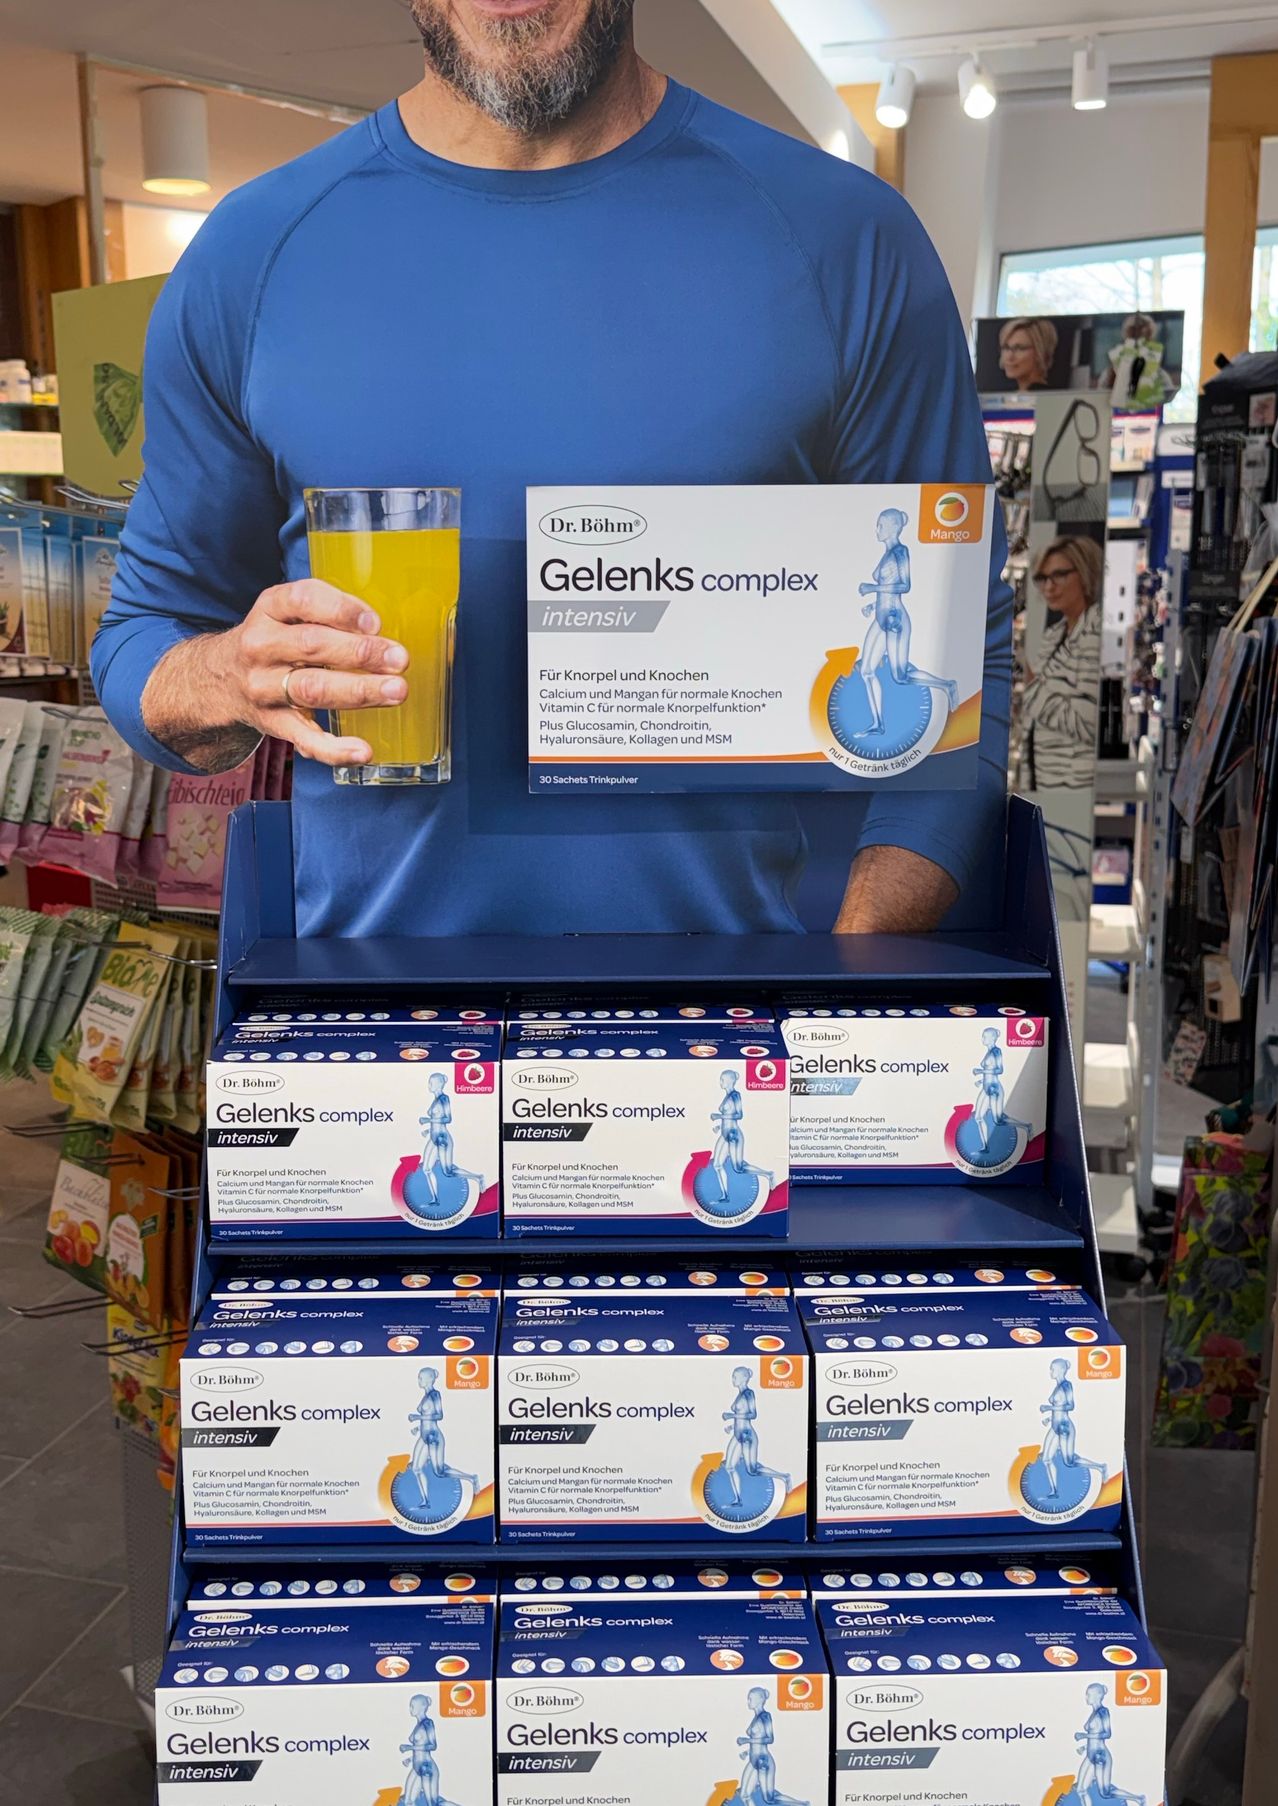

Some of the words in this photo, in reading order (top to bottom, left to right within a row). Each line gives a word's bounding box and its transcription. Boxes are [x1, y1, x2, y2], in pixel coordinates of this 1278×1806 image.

[550, 518, 576, 533] Dr.
[931, 529, 970, 541] Mango
[540, 558, 693, 592] Gelenks
[702, 568, 818, 597] complex
[542, 607, 635, 627] intensiv
[540, 669, 560, 681] Für
[564, 669, 615, 683] Knorpel
[620, 669, 645, 681] und
[650, 669, 709, 681] Knochen
[539, 689, 586, 699] Calcium
[589, 689, 611, 699] und
[615, 690, 658, 701] Mangan
[661, 689, 678, 699] für
[680, 689, 728, 699] normale
[731, 689, 782, 699] Knochen
[539, 703, 584, 713] Vitamin
[588, 704, 595, 713] C
[598, 703, 614, 713] für
[617, 703, 664, 713] normale
[539, 721, 563, 731] Plus
[566, 721, 637, 732] Glucosamin,
[640, 720, 712, 732] Chondroitin,
[539, 734, 627, 746] Hyaluronsäure,
[630, 734, 676, 747] Kollagen
[680, 734, 702, 744] und
[705, 734, 732, 744] MSM
[828, 746, 845, 760] nur
[844, 758, 849, 767] 1
[849, 761, 888, 773] Getränk
[889, 748, 921, 770] täglich
[539, 776, 551, 784] 30
[553, 776, 587, 784] Sachets
[589, 776, 638, 786] Trinkpulver
[793, 1033, 809, 1041] Dr.
[881, 1060, 948, 1076] complex
[223, 1078, 240, 1087] Dr.
[519, 1075, 535, 1083] Dr.
[216, 1102, 315, 1123] Gelenks
[319, 1108, 393, 1125] complex
[512, 1098, 607, 1118] Gelenks
[613, 1104, 685, 1121] complex
[800, 1116, 831, 1124] Knorpel
[513, 1126, 571, 1138] intensiv
[217, 1132, 278, 1144] intensiv
[233, 1169, 266, 1177] Knorpel
[527, 1164, 560, 1172] Knorpel
[213, 1310, 297, 1320] Gelenks
[300, 1311, 363, 1319] complex
[516, 1308, 598, 1316] Gelenks
[815, 1305, 897, 1315] Gelenks
[901, 1304, 964, 1313] complex
[515, 1372, 533, 1382] Dr.
[1086, 1370, 1112, 1378] Mango
[198, 1375, 216, 1385] Dr.
[454, 1380, 480, 1388] Mango
[768, 1379, 794, 1388] Mango
[509, 1397, 611, 1418] Gelenks
[617, 1402, 695, 1421] complex
[826, 1393, 929, 1415] Gelenks
[934, 1396, 1012, 1415] complex
[191, 1400, 296, 1422] Gelenks
[302, 1405, 380, 1423] complex
[510, 1428, 574, 1441] intensiv
[827, 1424, 891, 1438] intensiv
[193, 1432, 257, 1445] intensiv
[525, 1467, 560, 1475] Knorpel
[582, 1466, 623, 1474] Knochen
[826, 1464, 840, 1472] Für
[842, 1464, 878, 1472] Knorpel
[900, 1461, 940, 1469] Knochen
[209, 1470, 245, 1479] Knorpel
[514, 1616, 602, 1628] Gelenks
[606, 1617, 673, 1626] complex
[836, 1615, 924, 1625] Gelenks
[928, 1614, 995, 1624] complex
[189, 1624, 277, 1637] Gelenks
[281, 1624, 349, 1634] complex
[515, 1631, 567, 1639] intensiv
[841, 1628, 892, 1636] intensiv
[185, 1639, 238, 1648] intensiv
[515, 1696, 534, 1706] Dr.
[854, 1694, 873, 1704] Dr.
[1124, 1696, 1152, 1705] Mango
[786, 1701, 814, 1709] Mango
[174, 1706, 193, 1716] Dr.
[448, 1708, 477, 1716] Mango
[507, 1722, 617, 1746] Gelenks
[623, 1728, 707, 1748] complex
[847, 1719, 956, 1742] Gelenks
[962, 1724, 1045, 1743] complex
[167, 1731, 279, 1755] Gelenks
[285, 1735, 369, 1755] complex
[509, 1756, 577, 1770] intensiv
[848, 1753, 915, 1767] intensiv
[169, 1766, 238, 1780] intensiv
[525, 1797, 563, 1806] Knorpel
[565, 1796, 584, 1804] und
[587, 1796, 630, 1804] Knochen
[845, 1794, 860, 1802] Für
[863, 1793, 901, 1803] Knorpel
[924, 1791, 967, 1799] Knochen
